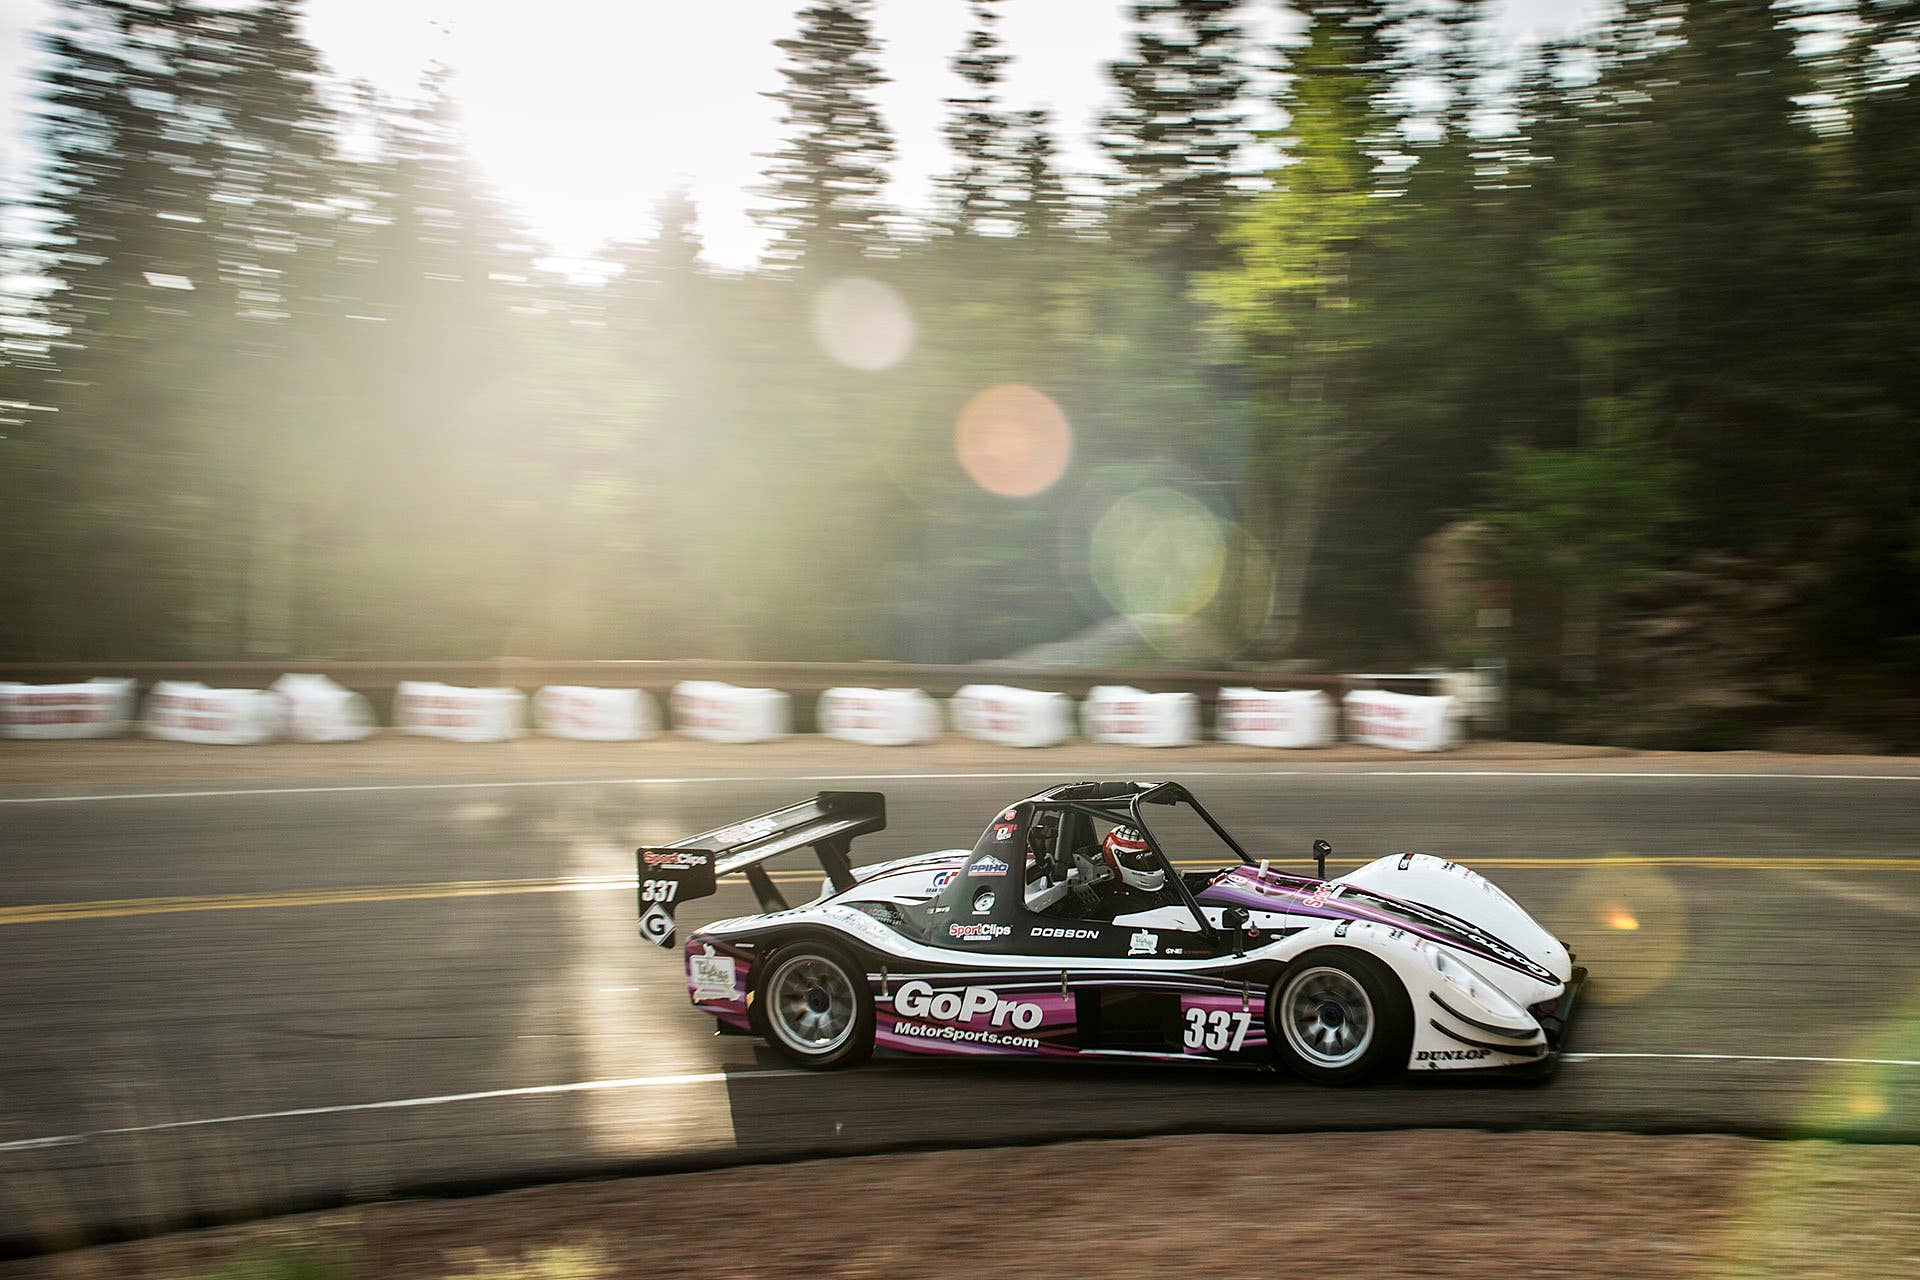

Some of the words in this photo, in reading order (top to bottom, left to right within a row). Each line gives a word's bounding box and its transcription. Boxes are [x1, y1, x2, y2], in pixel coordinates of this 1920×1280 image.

[641, 879, 679, 903] 337
[646, 913, 666, 936] G
[949, 923, 1012, 938] SportClips
[1030, 926, 1100, 940] DOBSON
[894, 980, 1044, 1031] GoPro
[894, 1021, 1040, 1048] MotorSports.com
[1183, 1007, 1253, 1053] 337
[1415, 1048, 1492, 1061] DUNLOP
